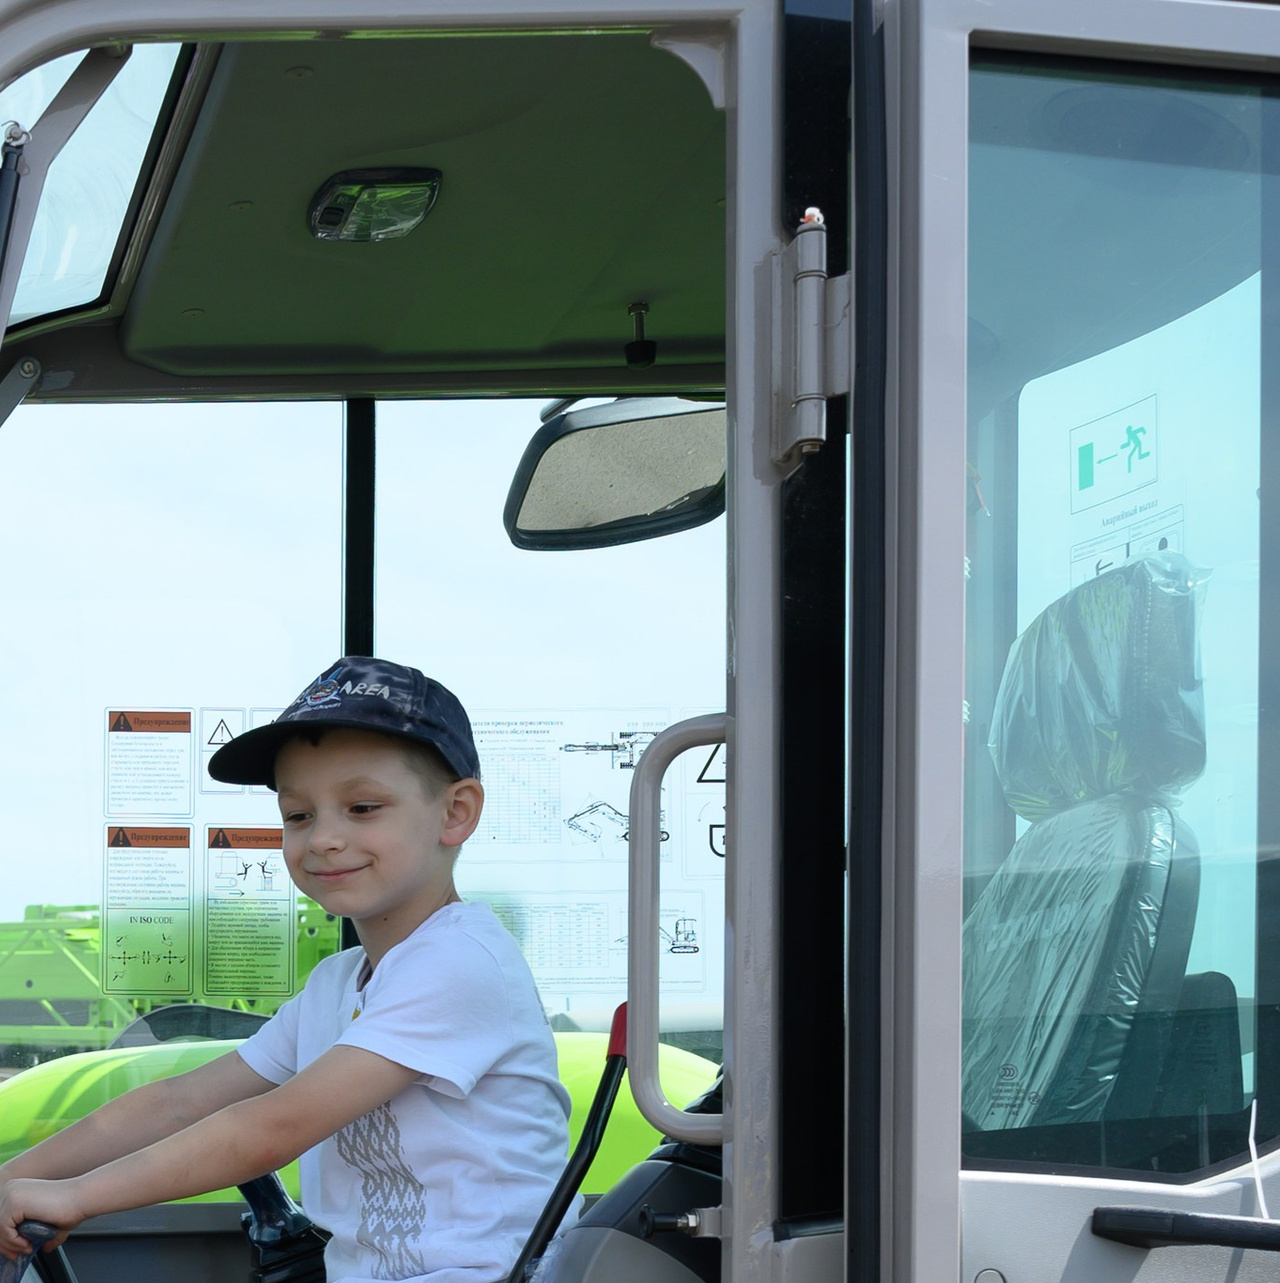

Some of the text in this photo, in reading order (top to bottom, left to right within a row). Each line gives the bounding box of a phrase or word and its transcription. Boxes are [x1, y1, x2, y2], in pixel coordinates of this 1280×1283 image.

[339, 680, 390, 700] AREA
[130, 832, 187, 842] Предупреждение
[231, 833, 283, 843] Предупреждени
[139, 916, 152, 924] ISO
[153, 916, 174, 924] CODE
